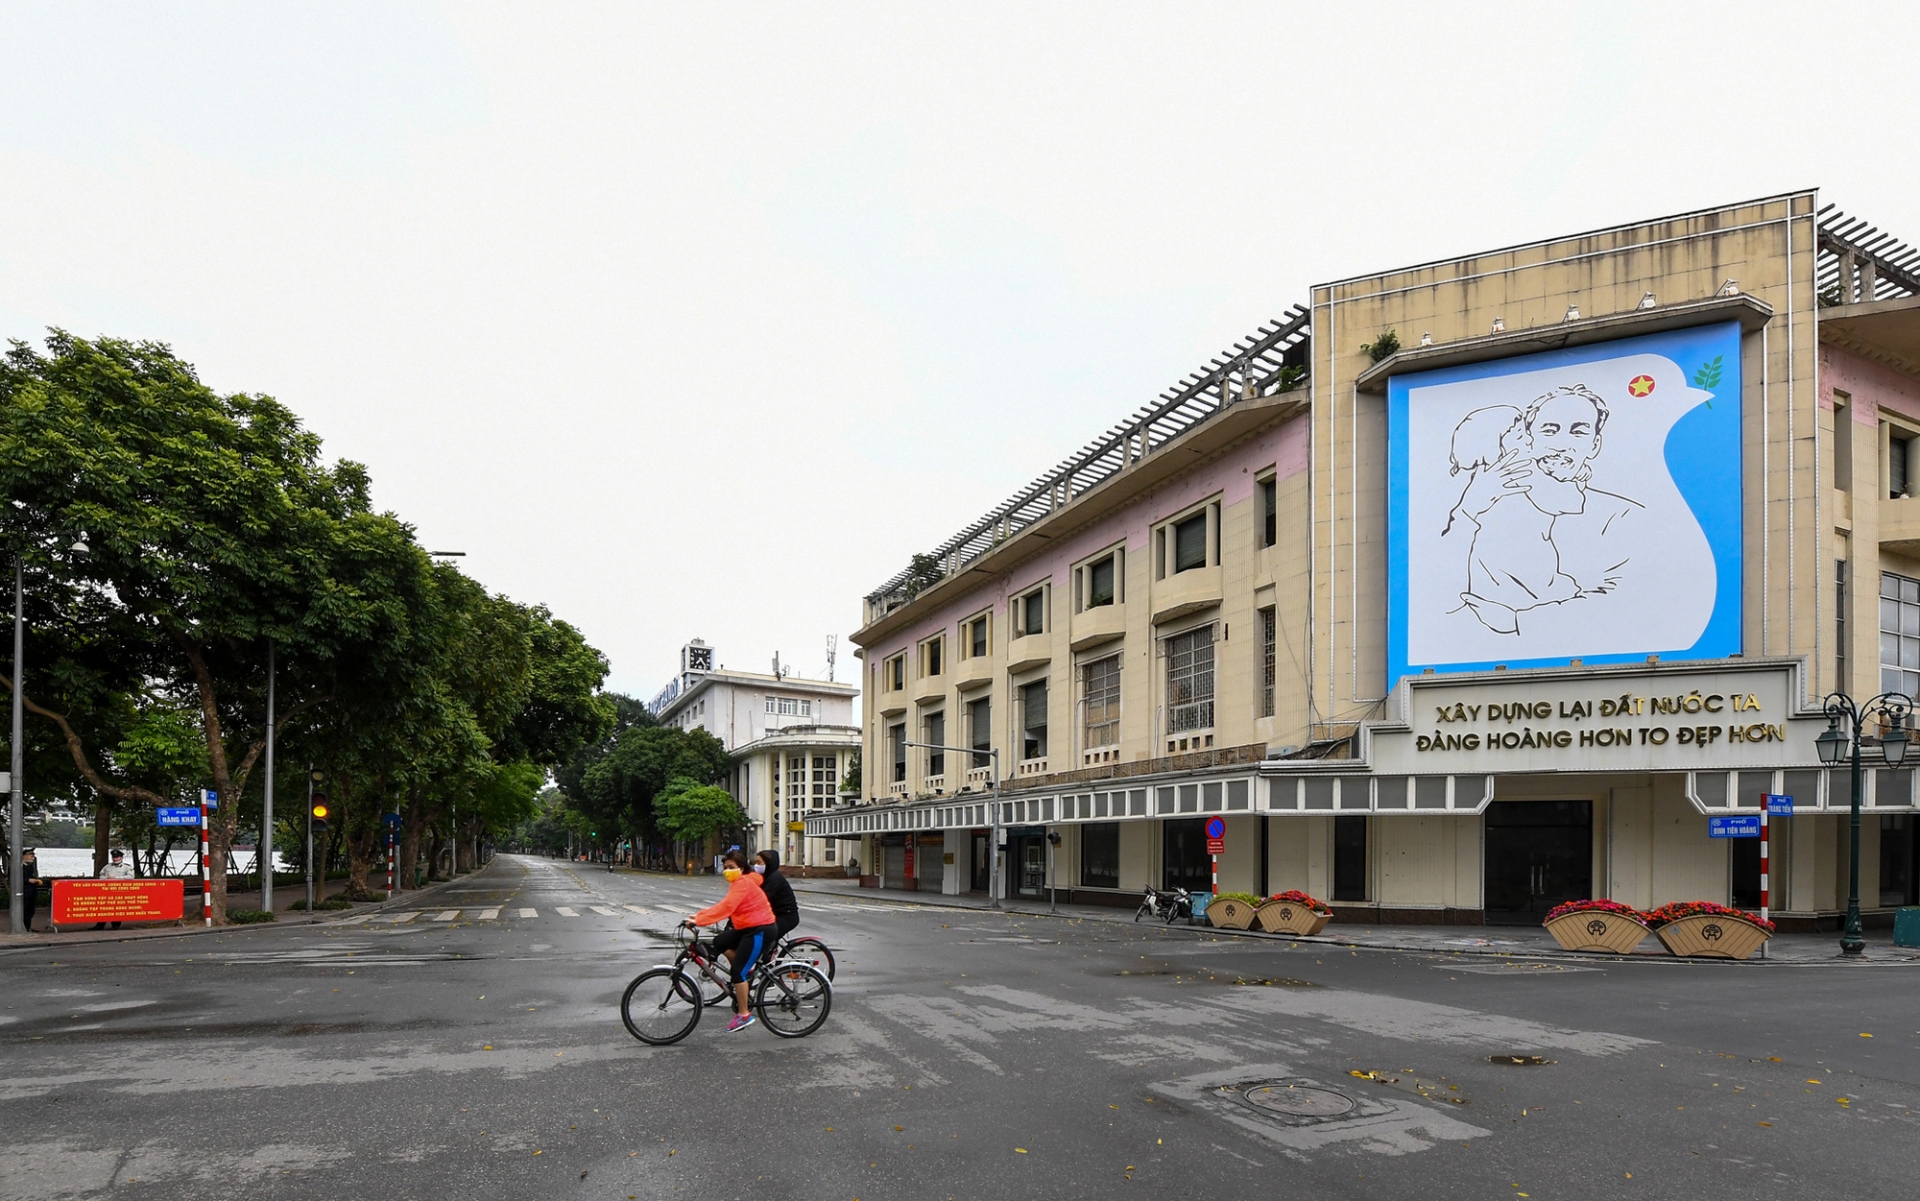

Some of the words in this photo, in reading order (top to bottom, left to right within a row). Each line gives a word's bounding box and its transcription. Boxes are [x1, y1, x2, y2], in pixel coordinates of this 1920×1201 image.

[1436, 702, 1482, 723] XÂY
[1488, 701, 1553, 724] DỰNG
[1559, 699, 1593, 721] LẠI
[1598, 691, 1645, 717] ĐẤT
[1650, 689, 1724, 716] NƯỚC
[1730, 692, 1761, 713] TA
[1416, 729, 1481, 751] ĐÀNG
[1487, 727, 1573, 750] HOÀNG
[1579, 727, 1632, 748] HƠN
[1639, 726, 1670, 746] TO
[1676, 725, 1723, 748] ĐẸP
[1729, 722, 1786, 744] HƠN
[1740, 826, 1757, 834] HOÀNG
